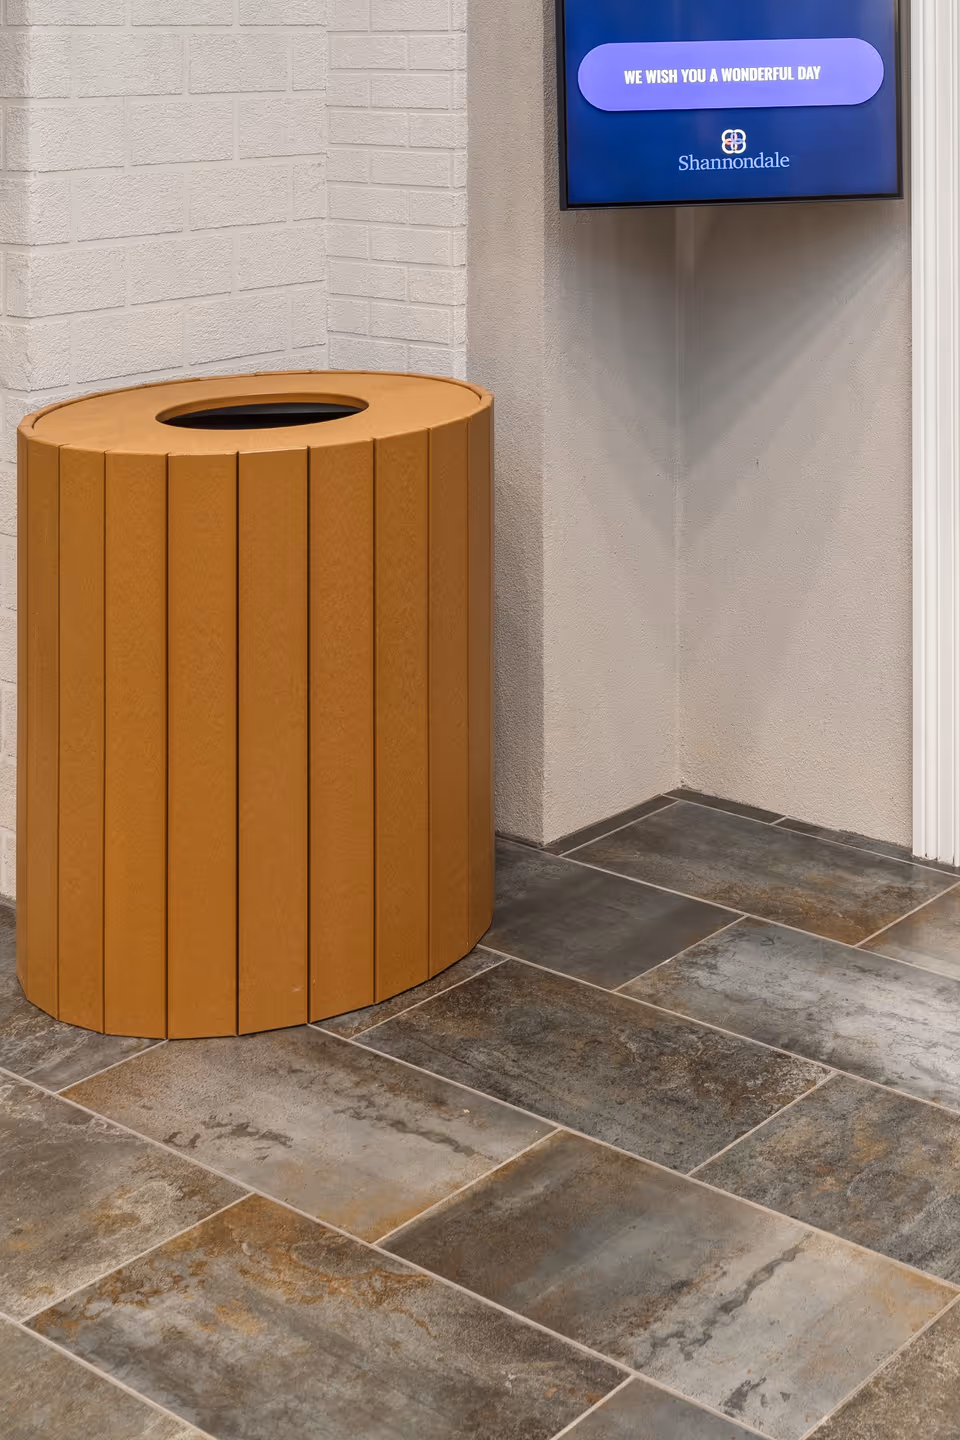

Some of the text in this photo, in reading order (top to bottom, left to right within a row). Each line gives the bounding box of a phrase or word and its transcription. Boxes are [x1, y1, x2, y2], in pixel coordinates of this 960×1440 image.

[623, 65, 822, 85] WE WISH YOU A WONDERFUL DAY
[678, 151, 790, 171] Shannondale
